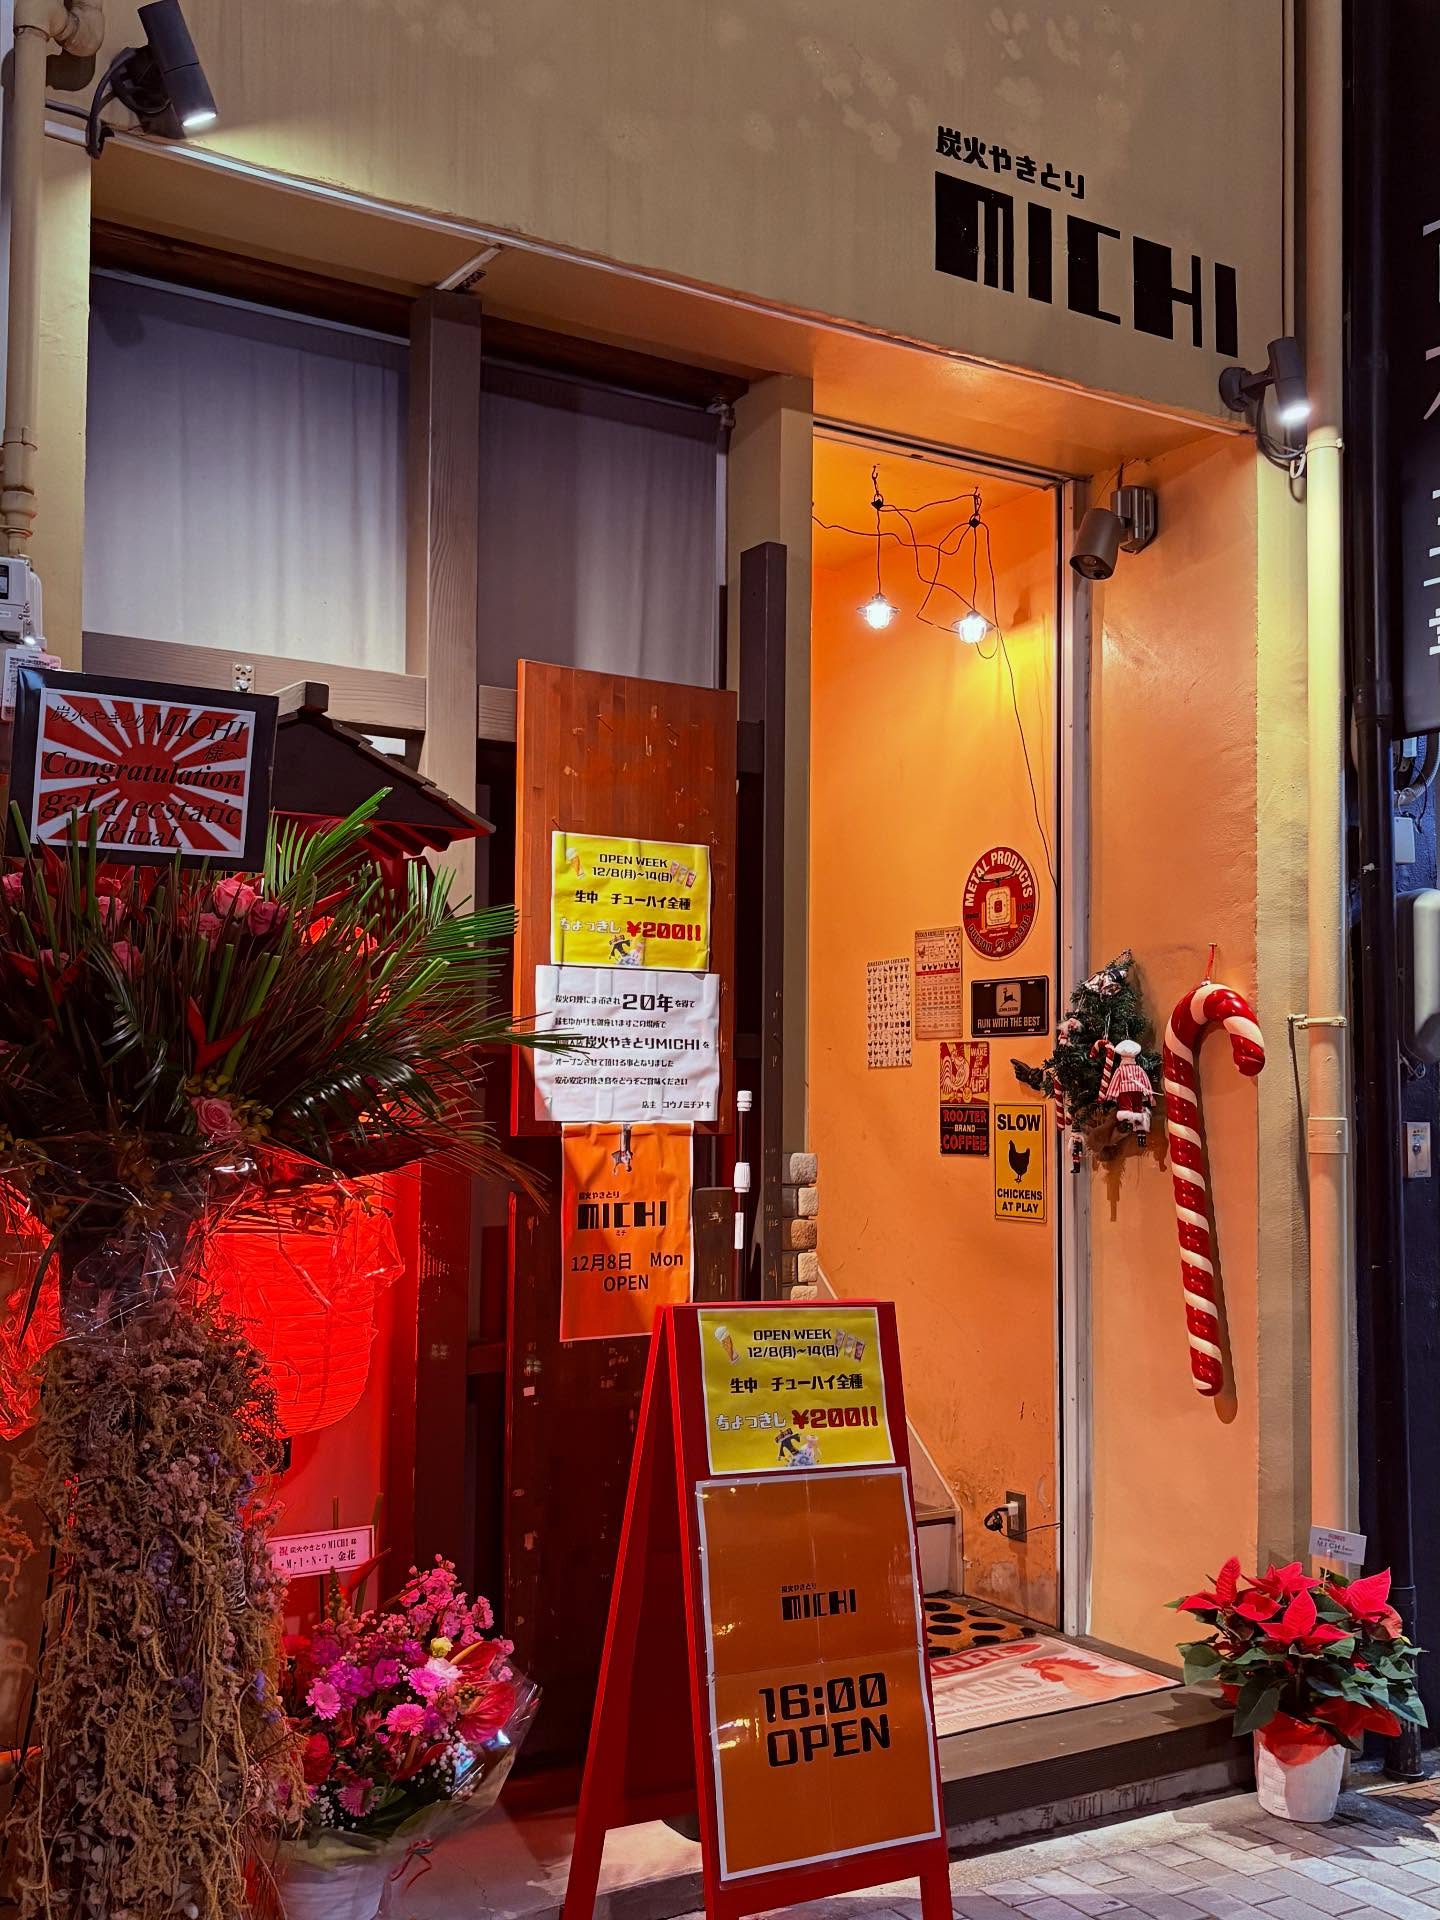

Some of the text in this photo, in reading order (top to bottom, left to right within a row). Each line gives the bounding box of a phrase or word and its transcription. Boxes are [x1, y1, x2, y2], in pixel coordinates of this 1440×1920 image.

[936, 126, 1085, 200] 炭火やきとり
[935, 171, 1238, 358] MICHI
[44, 751, 241, 789] Congratulation
[131, 799, 241, 825] ecstatic
[600, 854, 668, 868] OPEN WEEK
[964, 850, 1033, 907] METAL PRODUCTS
[575, 890, 691, 911] 生中 チューハイ全種
[977, 1016, 1040, 1028] RUN WITH THE BEST
[971, 1048, 988, 1056] WAKE
[943, 1110, 987, 1123] ROOSTER
[997, 1114, 1041, 1131] SLOW
[954, 1124, 976, 1132] BRAND
[943, 1135, 987, 1150] COFFEE
[997, 1188, 1042, 1201] CHICKENS
[577, 1201, 667, 1230] MICHI
[1002, 1201, 1039, 1214] AT PLAY
[571, 1252, 684, 1272] 12月8日 Mon
[604, 1274, 649, 1292] OPEN
[753, 1328, 832, 1341] OPEN WEEK
[730, 1373, 863, 1393] 生中 チューハイ全種
[781, 1589, 856, 1620] MICHI
[759, 1672, 887, 1723] 16:00
[767, 1713, 890, 1767] OPEN
